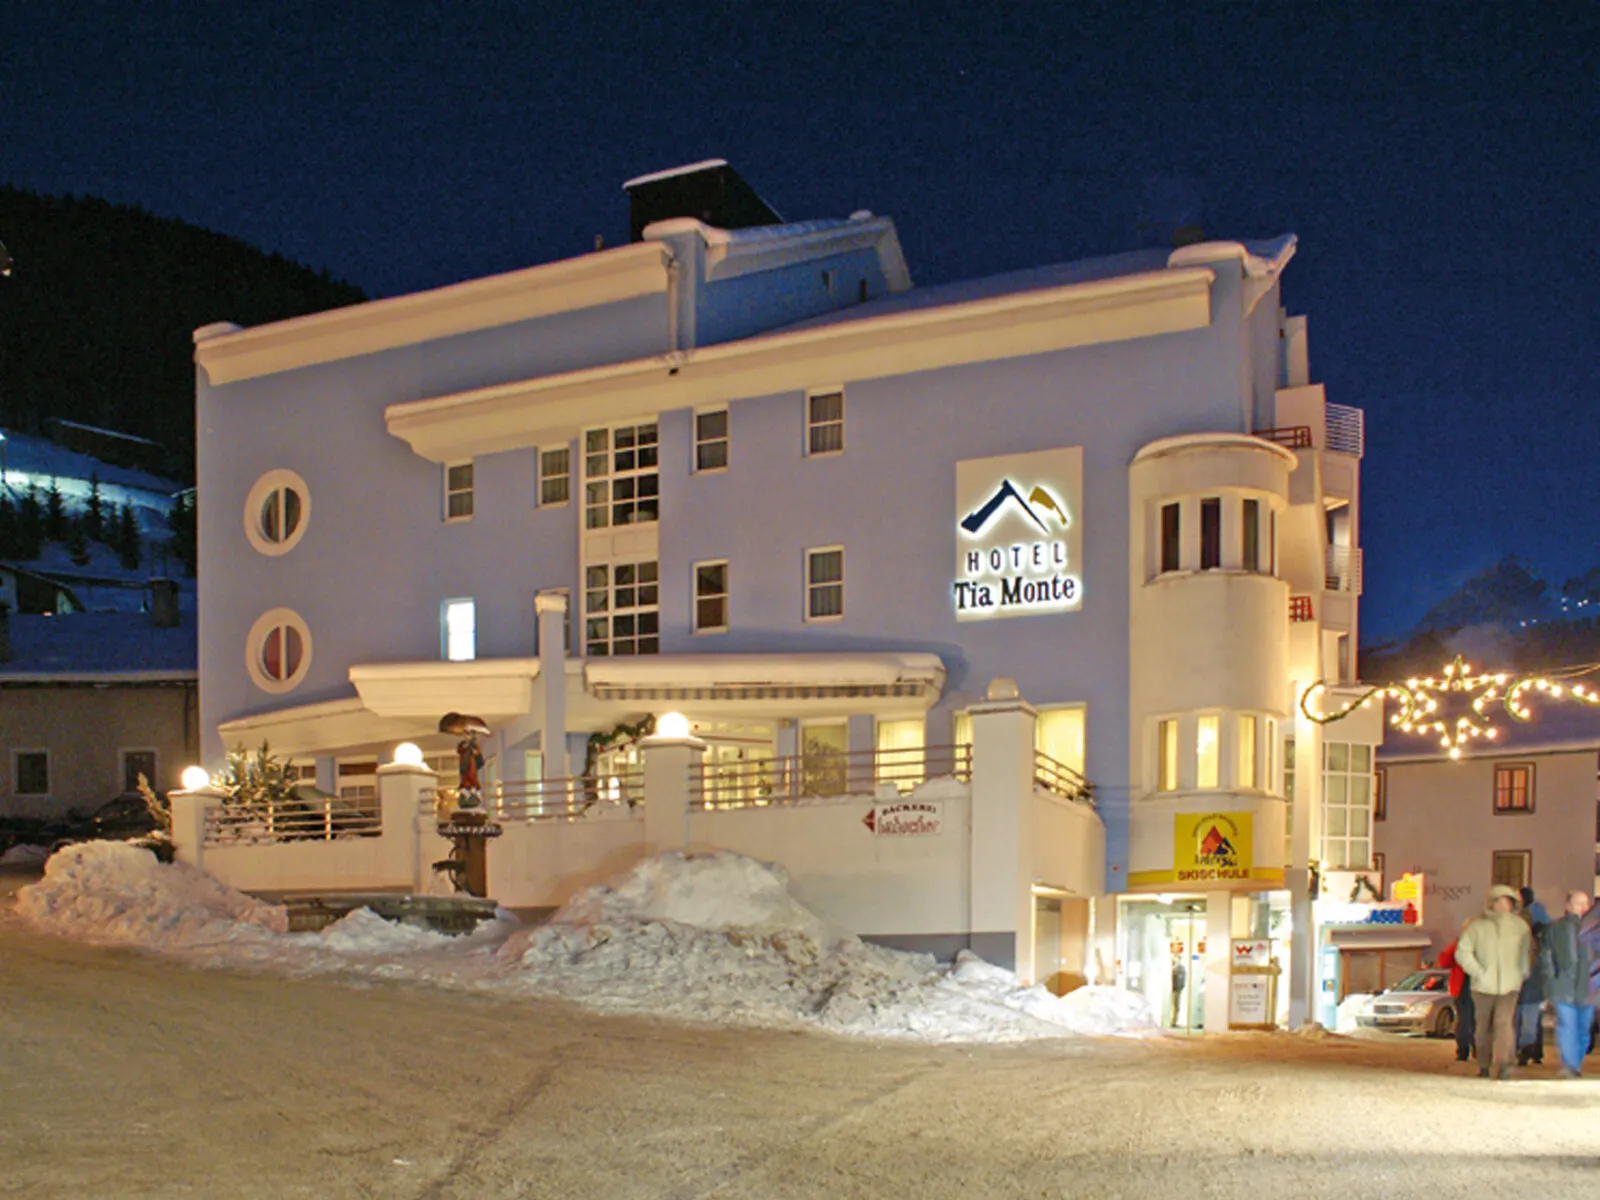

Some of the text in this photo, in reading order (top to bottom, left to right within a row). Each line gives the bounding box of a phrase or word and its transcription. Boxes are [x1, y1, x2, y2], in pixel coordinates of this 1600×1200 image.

[967, 542, 1063, 572] HOTEL
[955, 572, 1075, 610] Tia Monte
[1178, 868, 1250, 881] SKISCHULE
